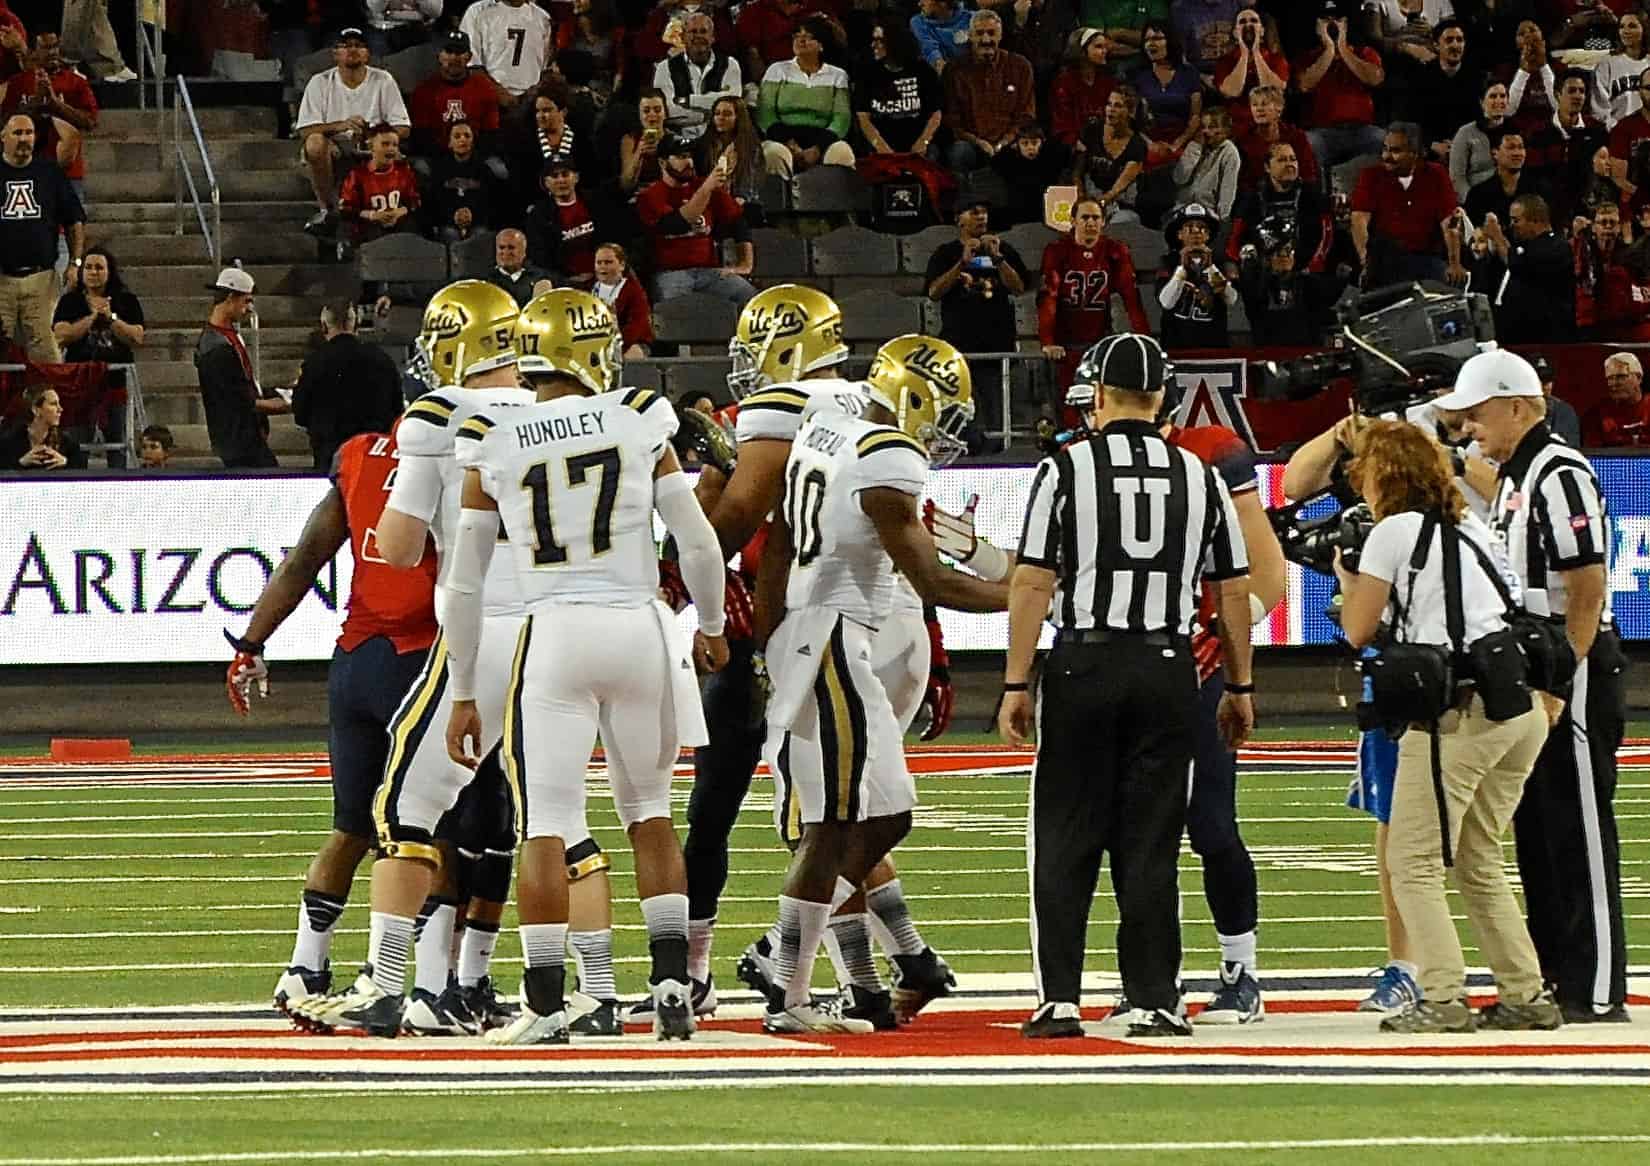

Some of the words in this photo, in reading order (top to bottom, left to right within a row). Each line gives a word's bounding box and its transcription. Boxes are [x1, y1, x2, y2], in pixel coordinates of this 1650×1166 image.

[507, 28, 526, 67] 7
[442, 100, 467, 122] A
[1, 180, 41, 220] A
[1064, 270, 1108, 311] 32
[521, 334, 540, 354] 17
[516, 411, 604, 448] HUNDLEY
[520, 446, 622, 568] 17
[1113, 478, 1171, 559] U
